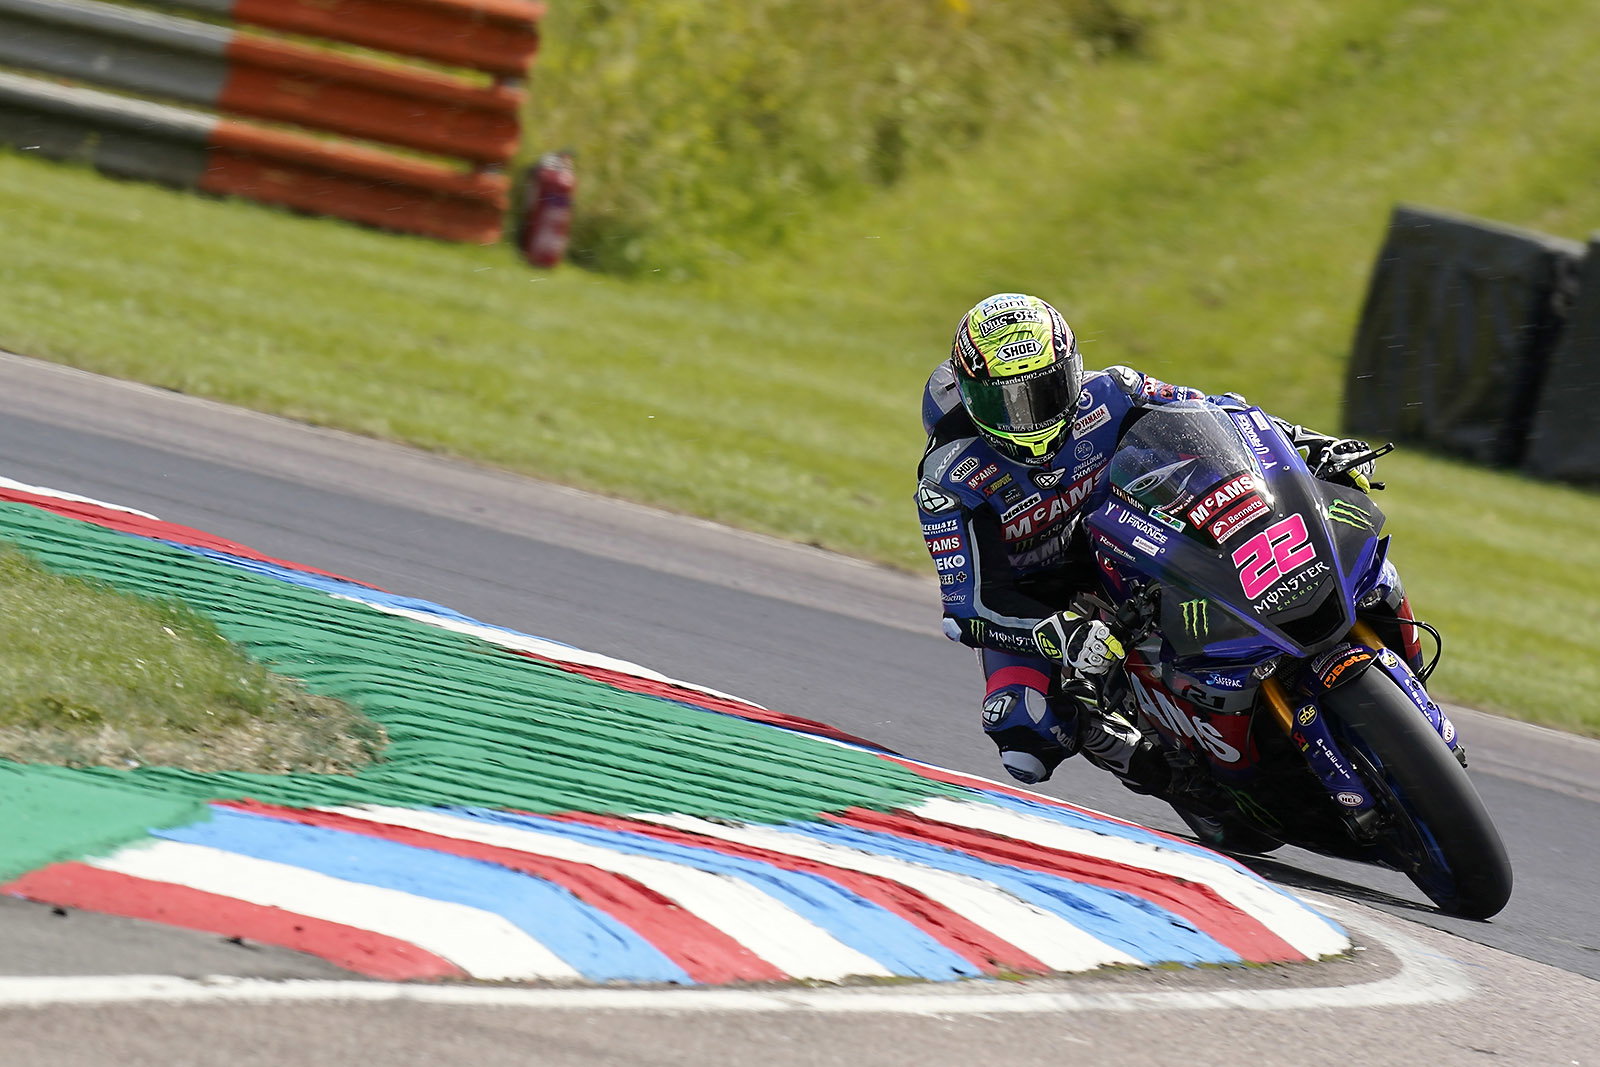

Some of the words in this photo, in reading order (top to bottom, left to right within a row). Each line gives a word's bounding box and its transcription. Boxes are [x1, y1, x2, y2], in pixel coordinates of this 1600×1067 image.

[1002, 341, 1038, 359] SHOEI
[1080, 407, 1106, 429] YAMAHA
[952, 457, 979, 480] SHOEI
[968, 464, 998, 489] McAMS
[1188, 476, 1256, 526] McAMS
[1228, 500, 1263, 524] Bennetts
[1127, 516, 1169, 544] FINANCE
[1231, 512, 1317, 600] 22
[1253, 561, 1330, 615] MONSTER
[1277, 581, 1320, 612] ENERGY
[1332, 653, 1371, 677] Beta
[1404, 678, 1434, 723] PIRELLI
[1130, 671, 1241, 763] AMS
[1299, 705, 1317, 725] sbs
[1316, 738, 1350, 780] PIRELLI
